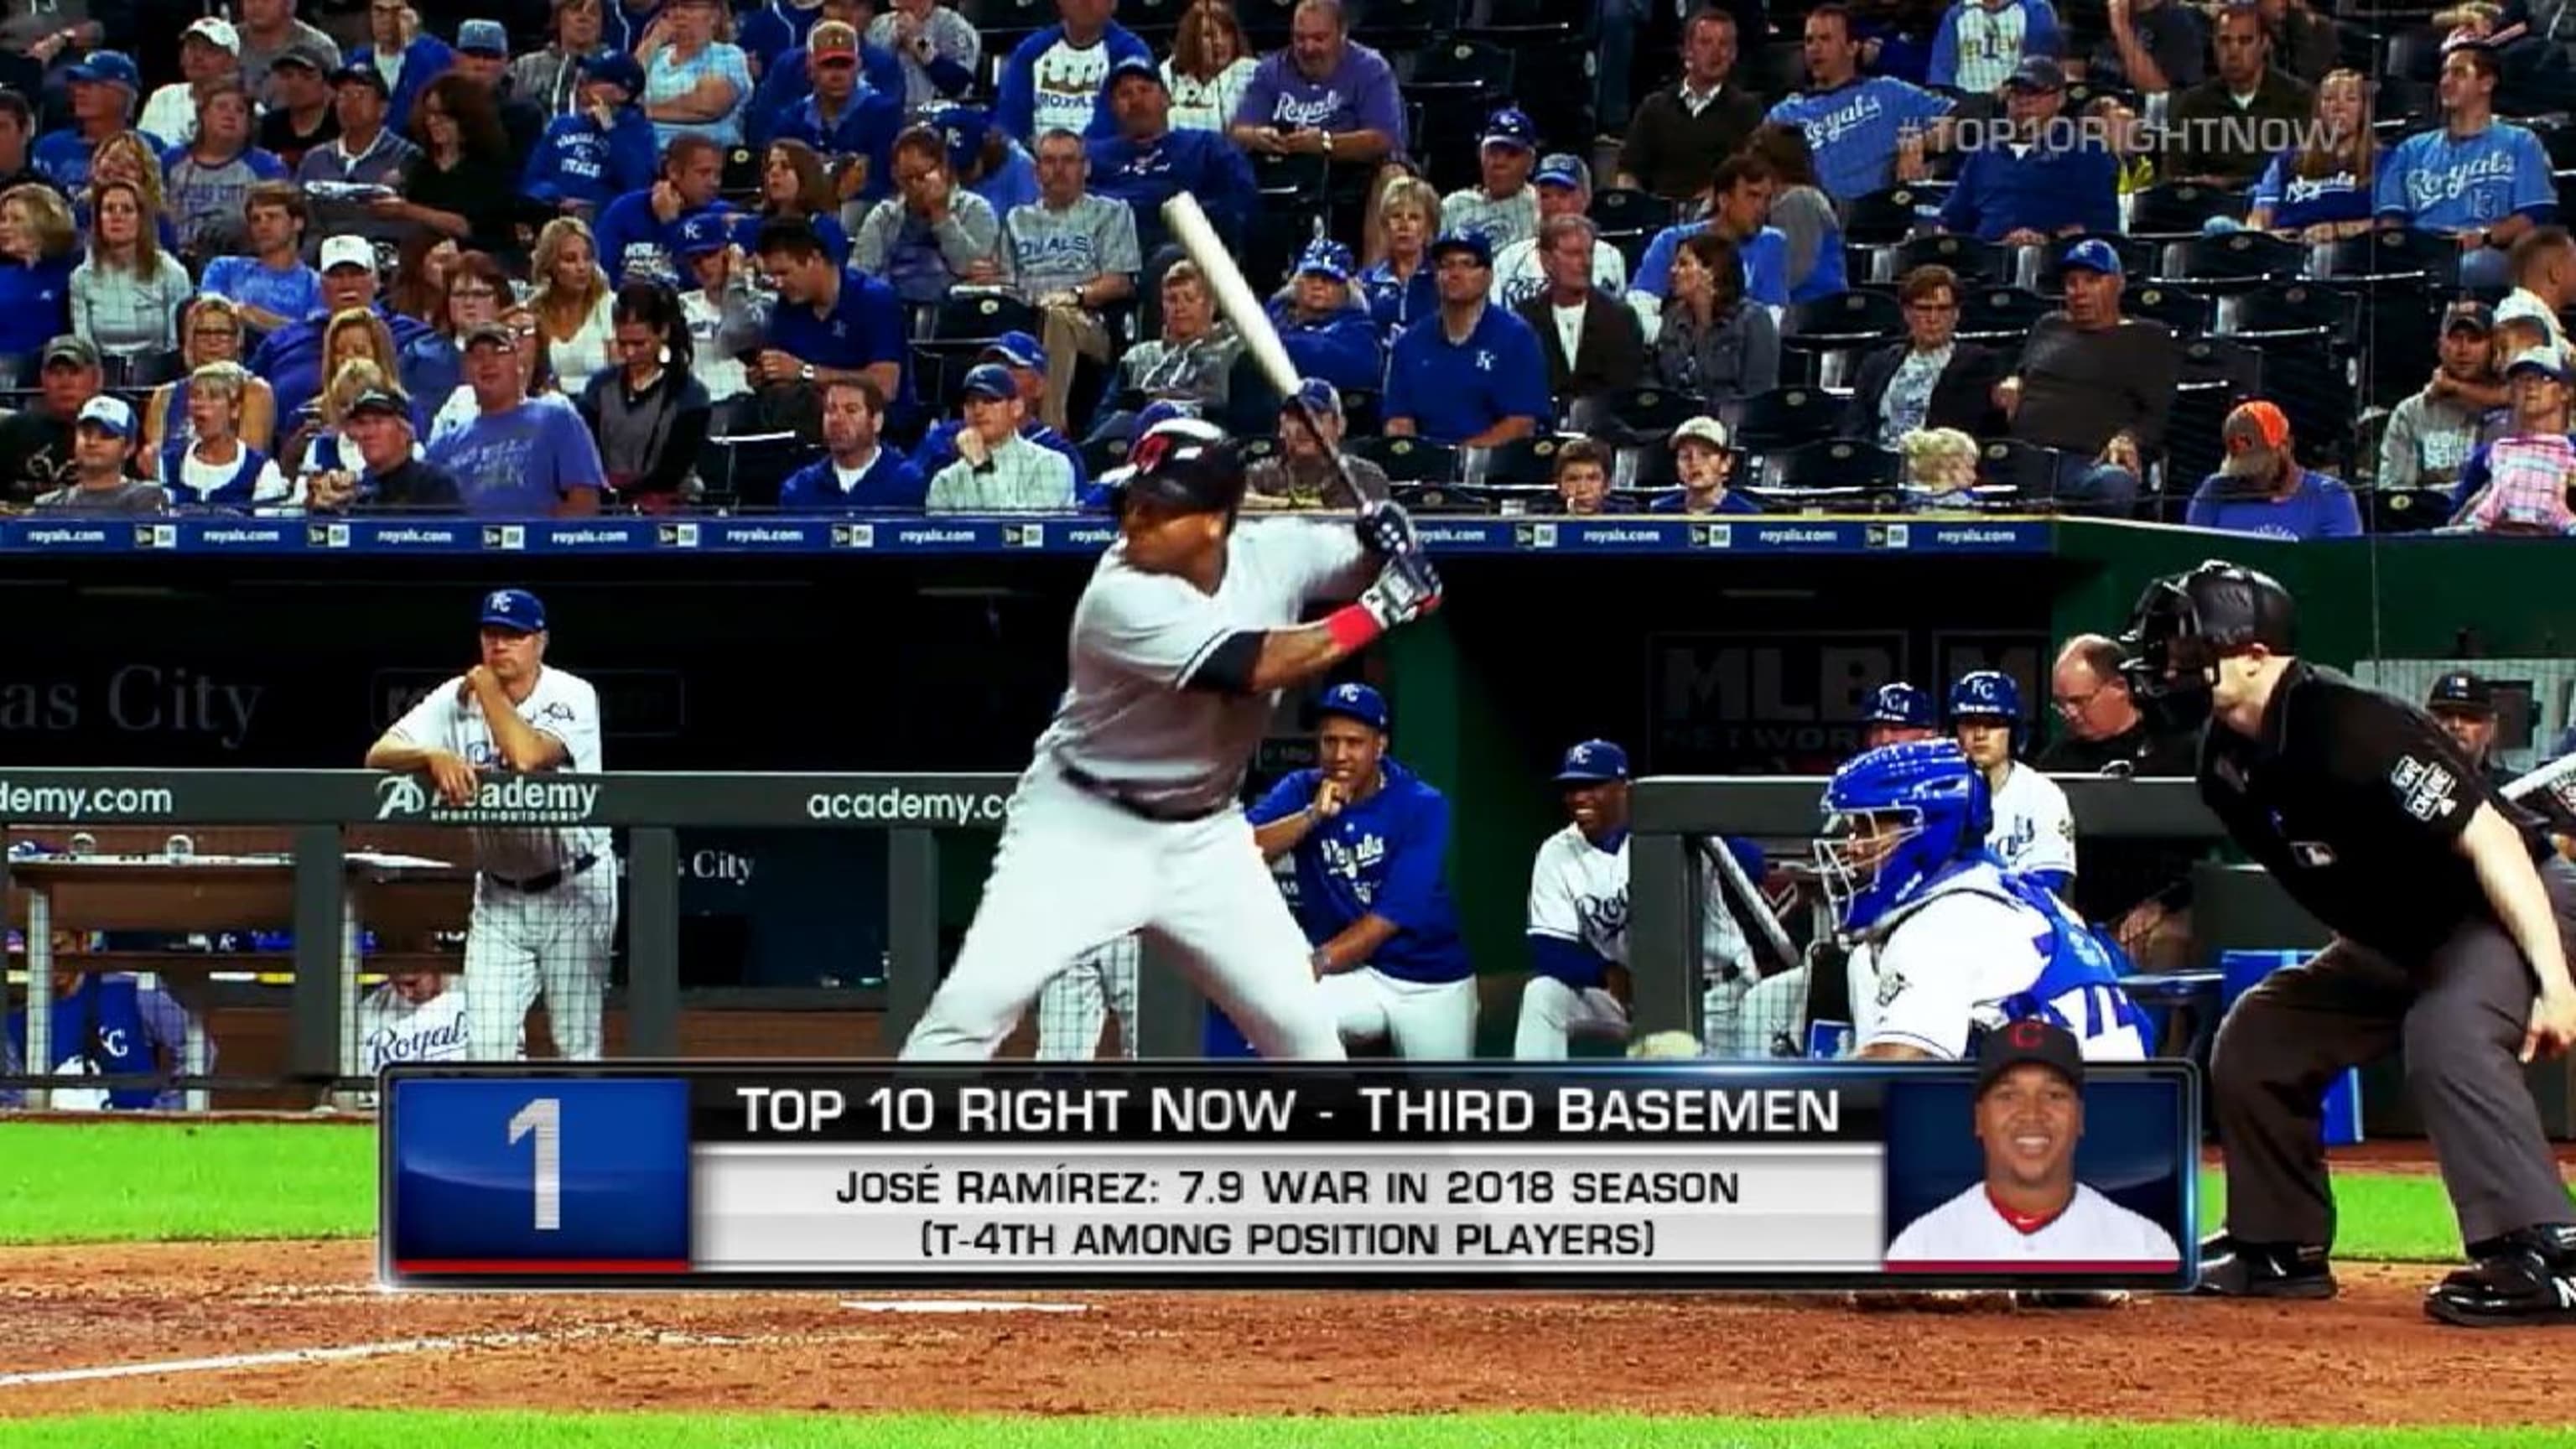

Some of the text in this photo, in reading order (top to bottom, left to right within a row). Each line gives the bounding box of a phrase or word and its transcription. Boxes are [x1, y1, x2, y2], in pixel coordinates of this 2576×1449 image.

[2407, 151, 2515, 208] Royals
[29, 529, 105, 544] royals.com
[203, 529, 279, 543] royals.com
[378, 529, 452, 544] royals.com
[552, 530, 628, 544] royals.com
[726, 529, 803, 543] royals.com
[900, 529, 975, 544] royals.com
[1583, 528, 1660, 543] royals.com
[1759, 529, 1837, 544] royals.com
[1937, 529, 2016, 544] royals.com
[107, 663, 262, 748] City
[1660, 724, 1859, 751] NETWOR
[432, 775, 599, 818] ademy
[693, 849, 755, 886] City
